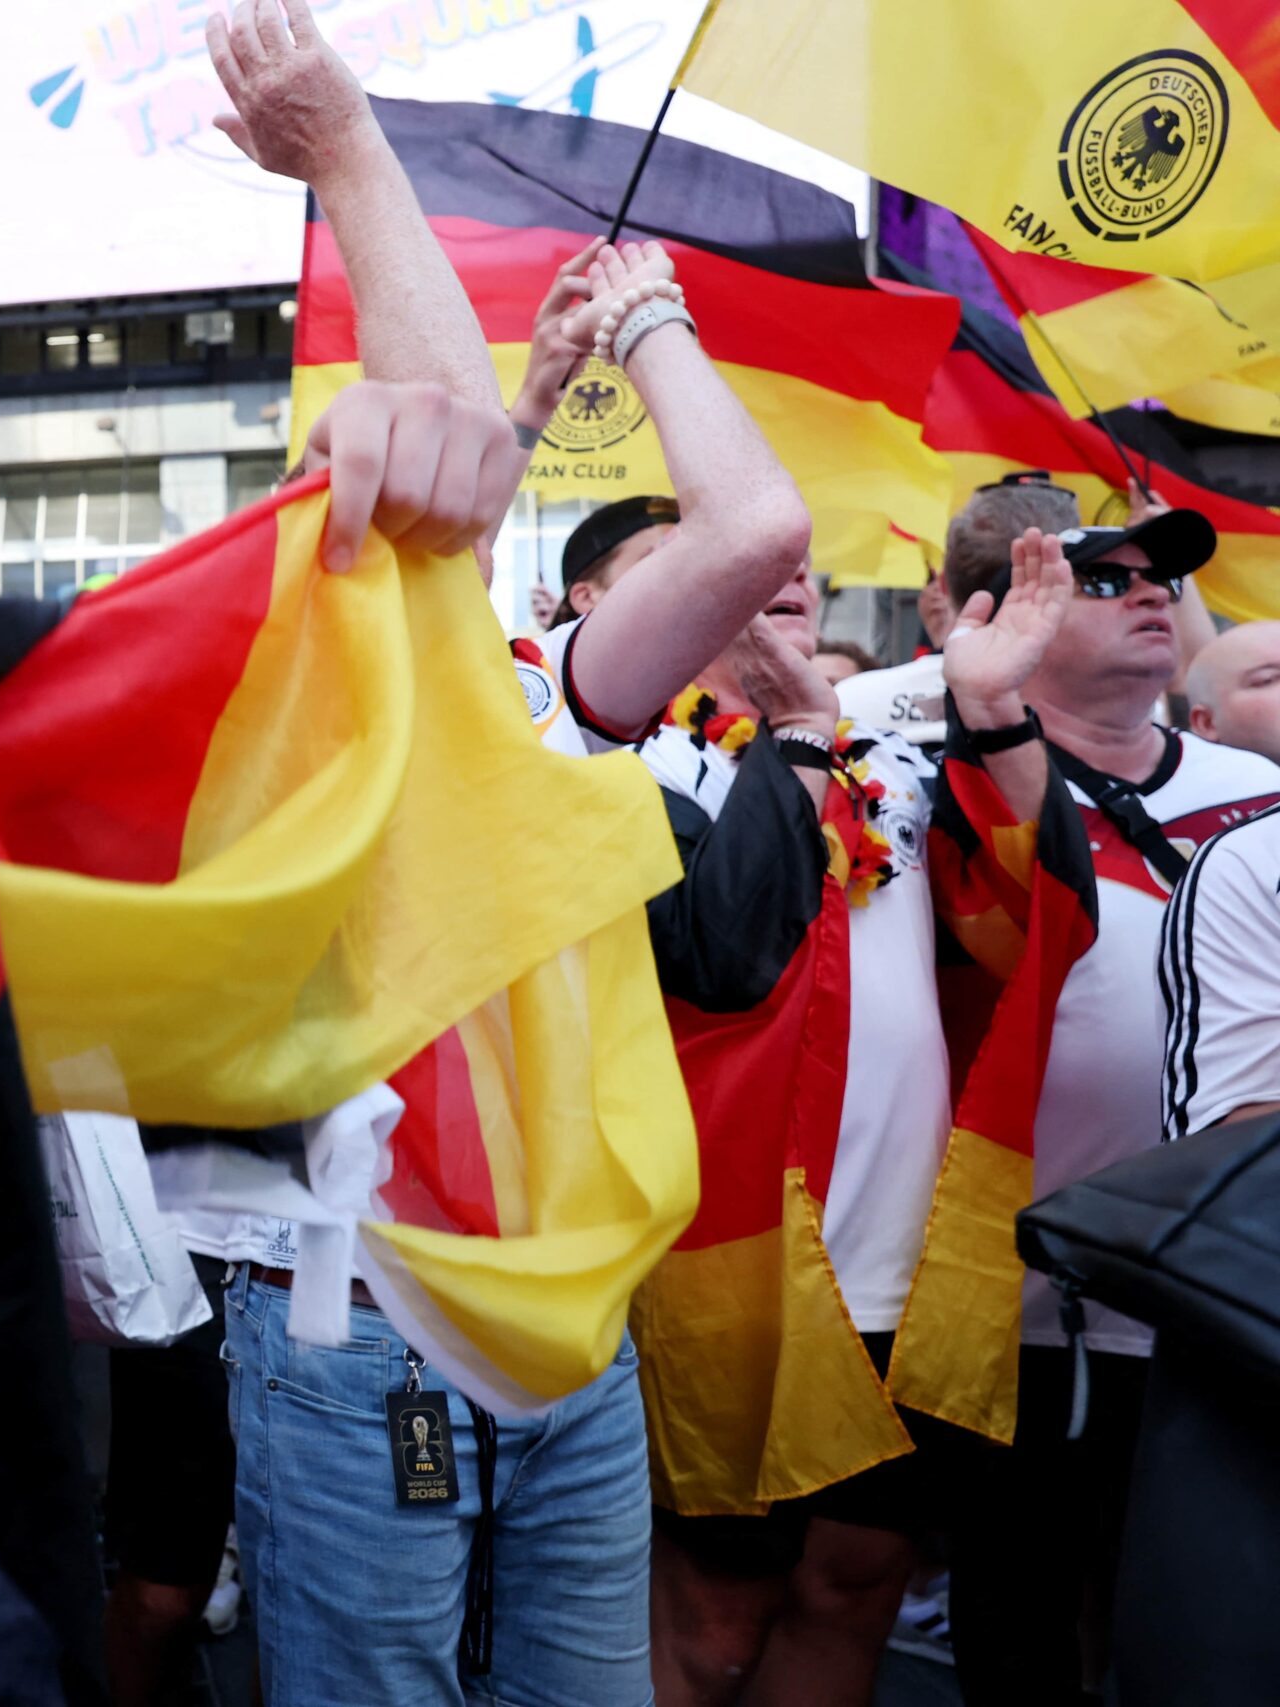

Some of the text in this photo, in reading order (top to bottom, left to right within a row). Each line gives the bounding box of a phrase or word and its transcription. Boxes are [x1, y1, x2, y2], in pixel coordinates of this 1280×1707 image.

[1149, 75, 1208, 146] DEUTSCHER
[1085, 129, 1166, 218] FUSSBALL-BUND
[1003, 204, 1056, 247] FAN
[526, 463, 627, 479] FAN CLUB
[415, 1463, 435, 1472] FIFA
[407, 1479, 447, 1488] WORLD CUP
[408, 1488, 448, 1499] 2026
